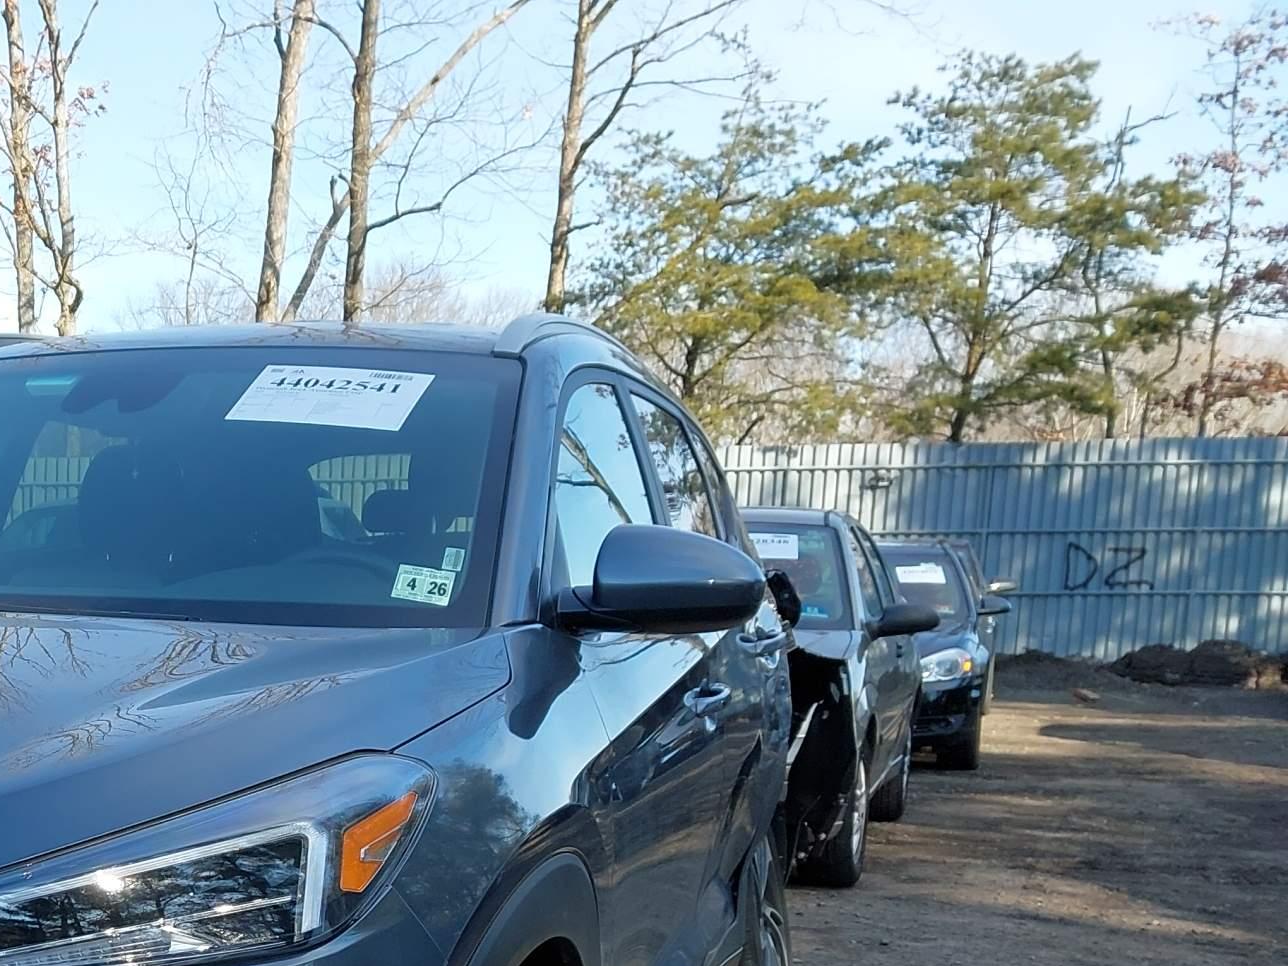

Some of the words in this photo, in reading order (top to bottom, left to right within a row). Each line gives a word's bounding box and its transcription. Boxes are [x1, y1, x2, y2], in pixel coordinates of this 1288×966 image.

[270, 377, 401, 394] 44042541
[1064, 541, 1154, 592] DZ
[407, 577, 417, 591] 4
[427, 581, 448, 597] 26
